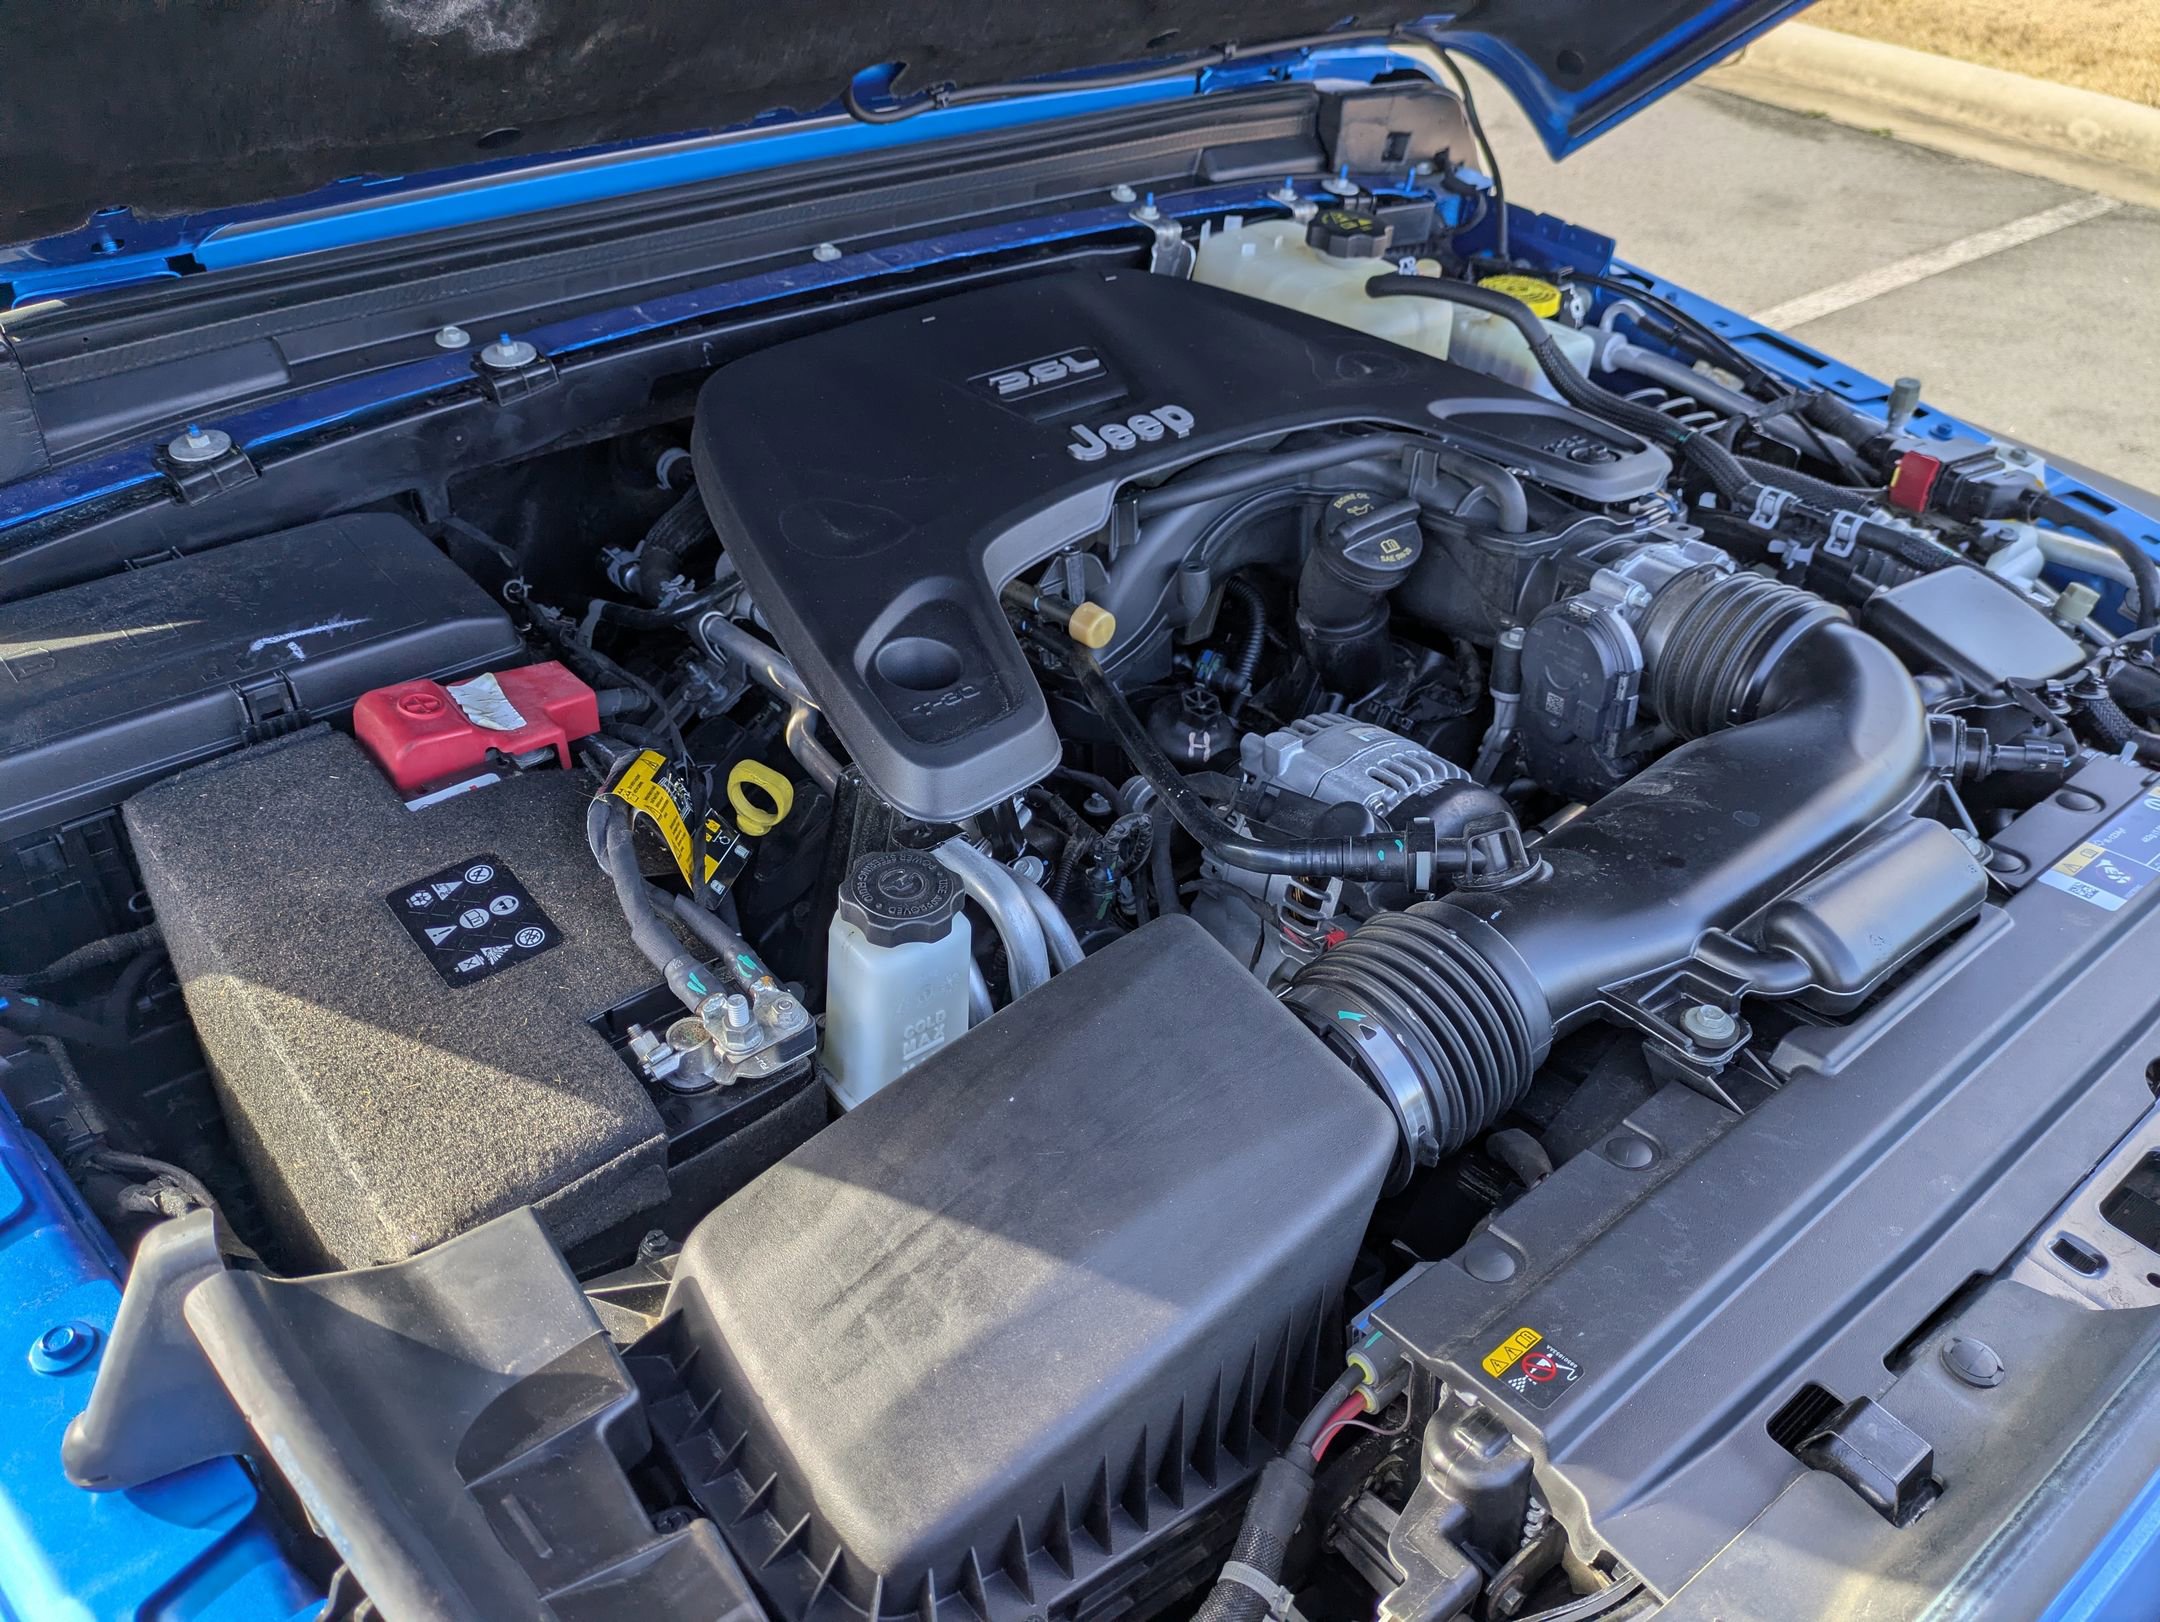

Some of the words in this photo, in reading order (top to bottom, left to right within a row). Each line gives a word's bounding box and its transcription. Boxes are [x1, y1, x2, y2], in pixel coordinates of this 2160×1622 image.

[989, 355, 1100, 395] 3.6L
[1067, 404, 1195, 462] Jeep
[857, 854, 897, 881] STEERING
[900, 854, 937, 870] POWER
[856, 881, 874, 903] FLUID
[937, 878, 949, 895] USE
[888, 894, 943, 916] APPROVED
[903, 1009, 946, 1039] COLD
[903, 1023, 945, 1058] MAX
